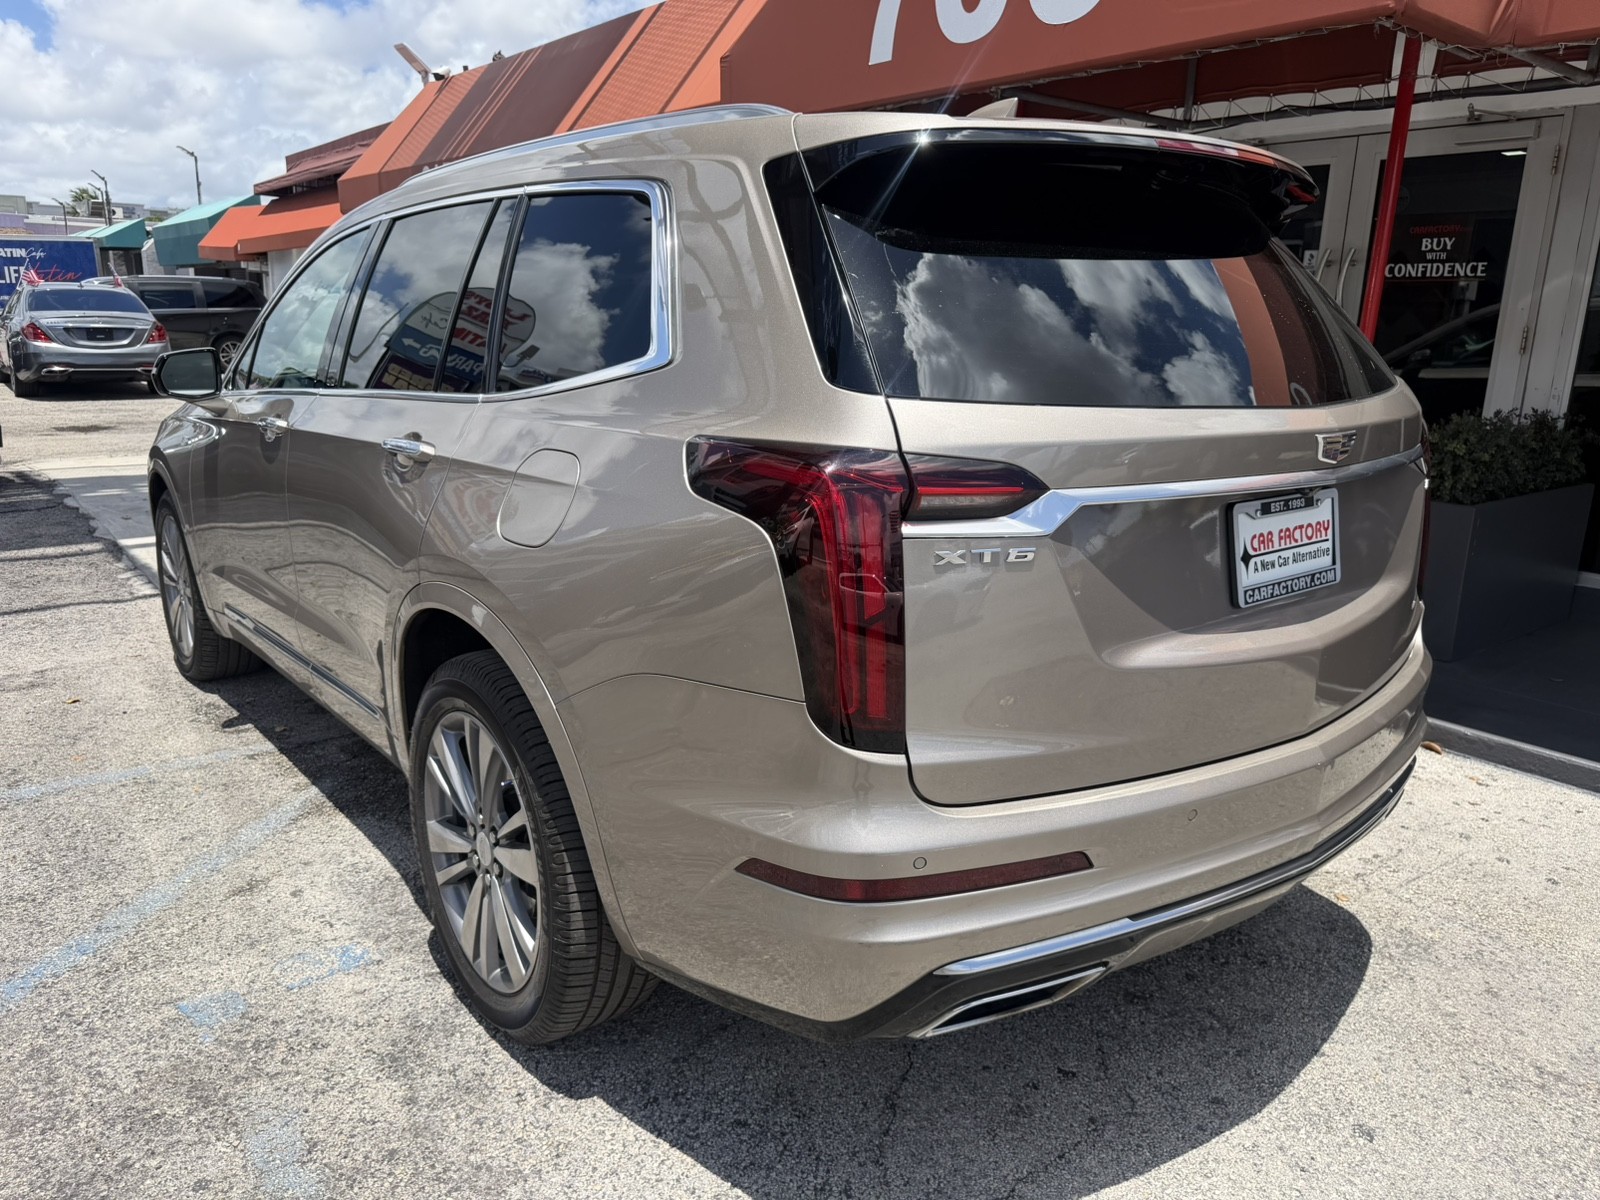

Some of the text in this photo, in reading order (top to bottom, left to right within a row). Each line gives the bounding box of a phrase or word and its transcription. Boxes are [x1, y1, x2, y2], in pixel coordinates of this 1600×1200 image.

[1421, 237, 1455, 251] BUY
[1426, 252, 1447, 260] WITH
[1384, 262, 1488, 278] CONFIDENCE
[1270, 501, 1287, 513] EST.
[1250, 519, 1330, 552] CAR FACTORY
[933, 548, 1036, 566] XT6
[1253, 546, 1331, 574] A New Car Alternative
[1246, 569, 1335, 603] CARFACTORY.COM
